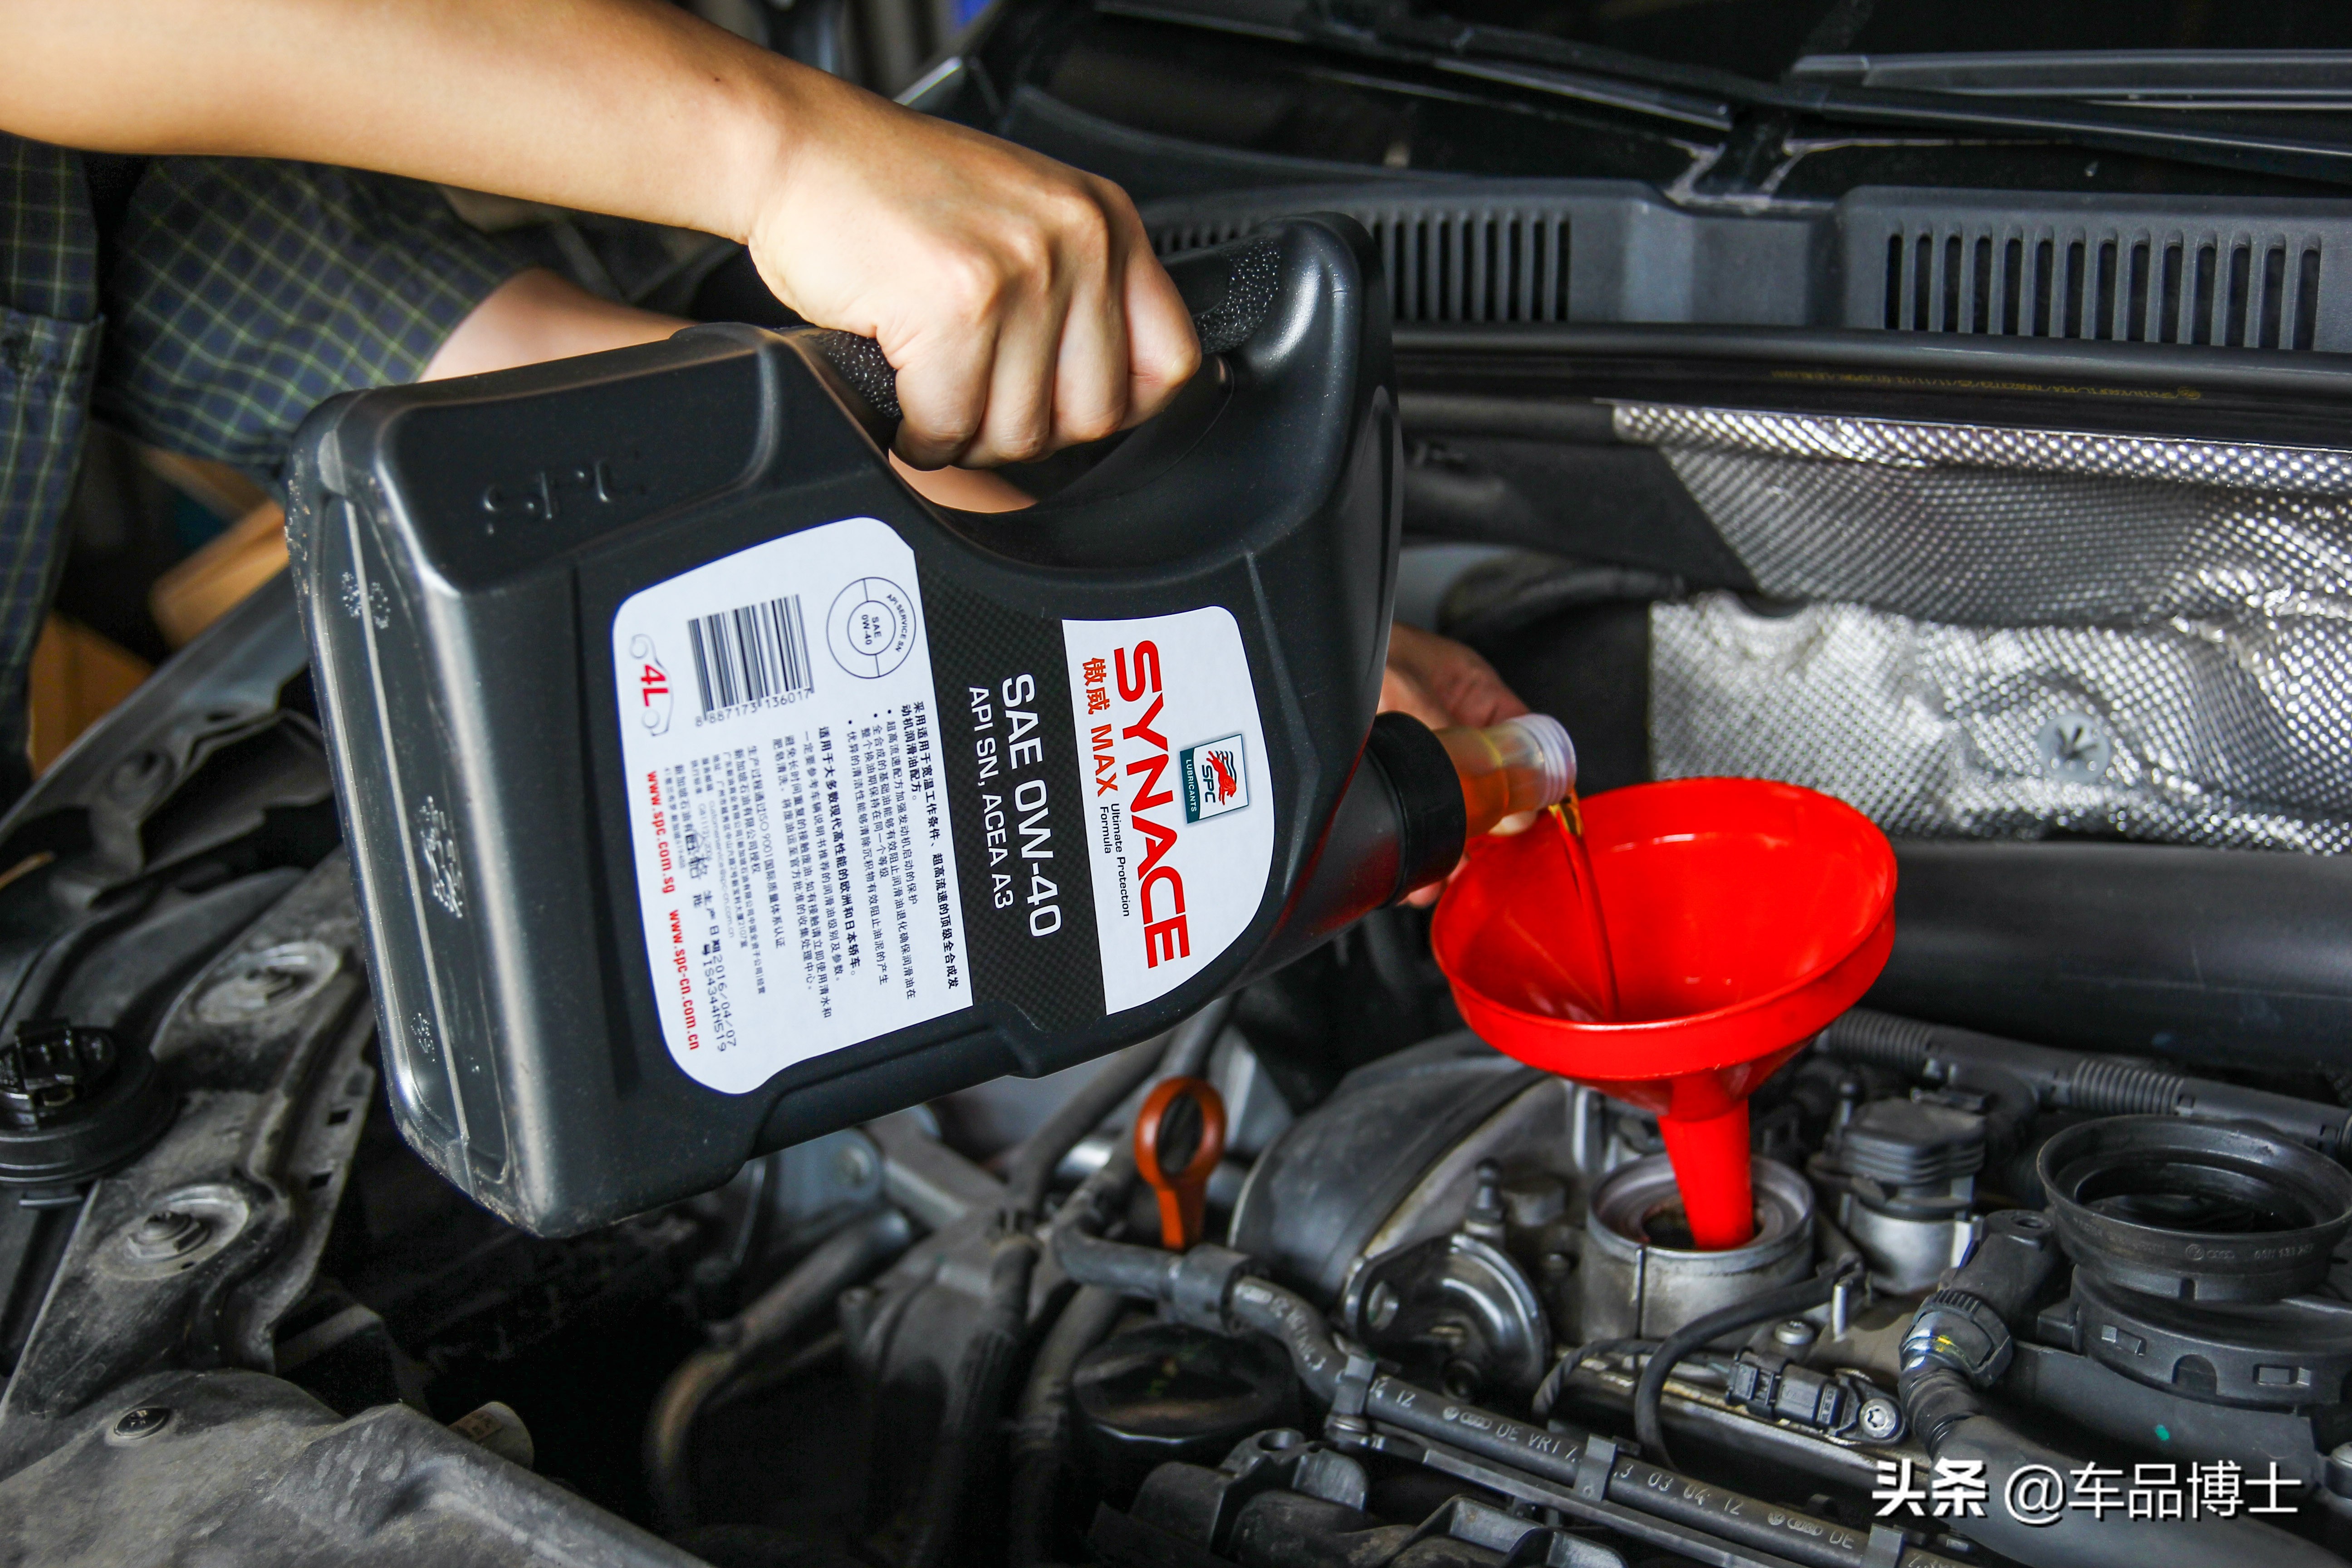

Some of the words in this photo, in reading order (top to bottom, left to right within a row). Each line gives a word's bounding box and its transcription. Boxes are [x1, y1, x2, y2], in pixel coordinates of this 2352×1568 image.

[886, 594, 898, 608] API
[897, 604, 907, 639] SERVICE
[862, 614, 872, 645] 0W-40
[872, 616, 882, 637] SAE
[895, 641, 904, 652] SN
[640, 663, 668, 706] 4L
[694, 715, 703, 727] 8
[708, 702, 758, 724] 887173
[764, 687, 813, 709] 136017
[969, 687, 994, 731] API
[1083, 657, 1111, 715] 傲威
[1002, 674, 1043, 769] SAE
[900, 703, 922, 800] 动机润滑油配方。
[976, 737, 999, 787] SN,
[1091, 724, 1118, 797] MAX
[1114, 640, 1190, 969] SYNACE
[1186, 759, 1197, 812] LUBRICANTS
[1201, 764, 1216, 803] SPC
[913, 700, 960, 990] 采用适用于宽温工作条件、超高流速的顶级全合成发
[982, 794, 1009, 867] ACEA
[1100, 806, 1112, 854] Formula
[1014, 779, 1062, 937] 0W-40
[1111, 803, 1123, 853] Ultimate
[1117, 856, 1130, 917] Protection
[648, 769, 676, 895] www.spc.com.sg
[669, 909, 699, 1050] www.spc-cn.com.cn
[991, 873, 1014, 909] A3
